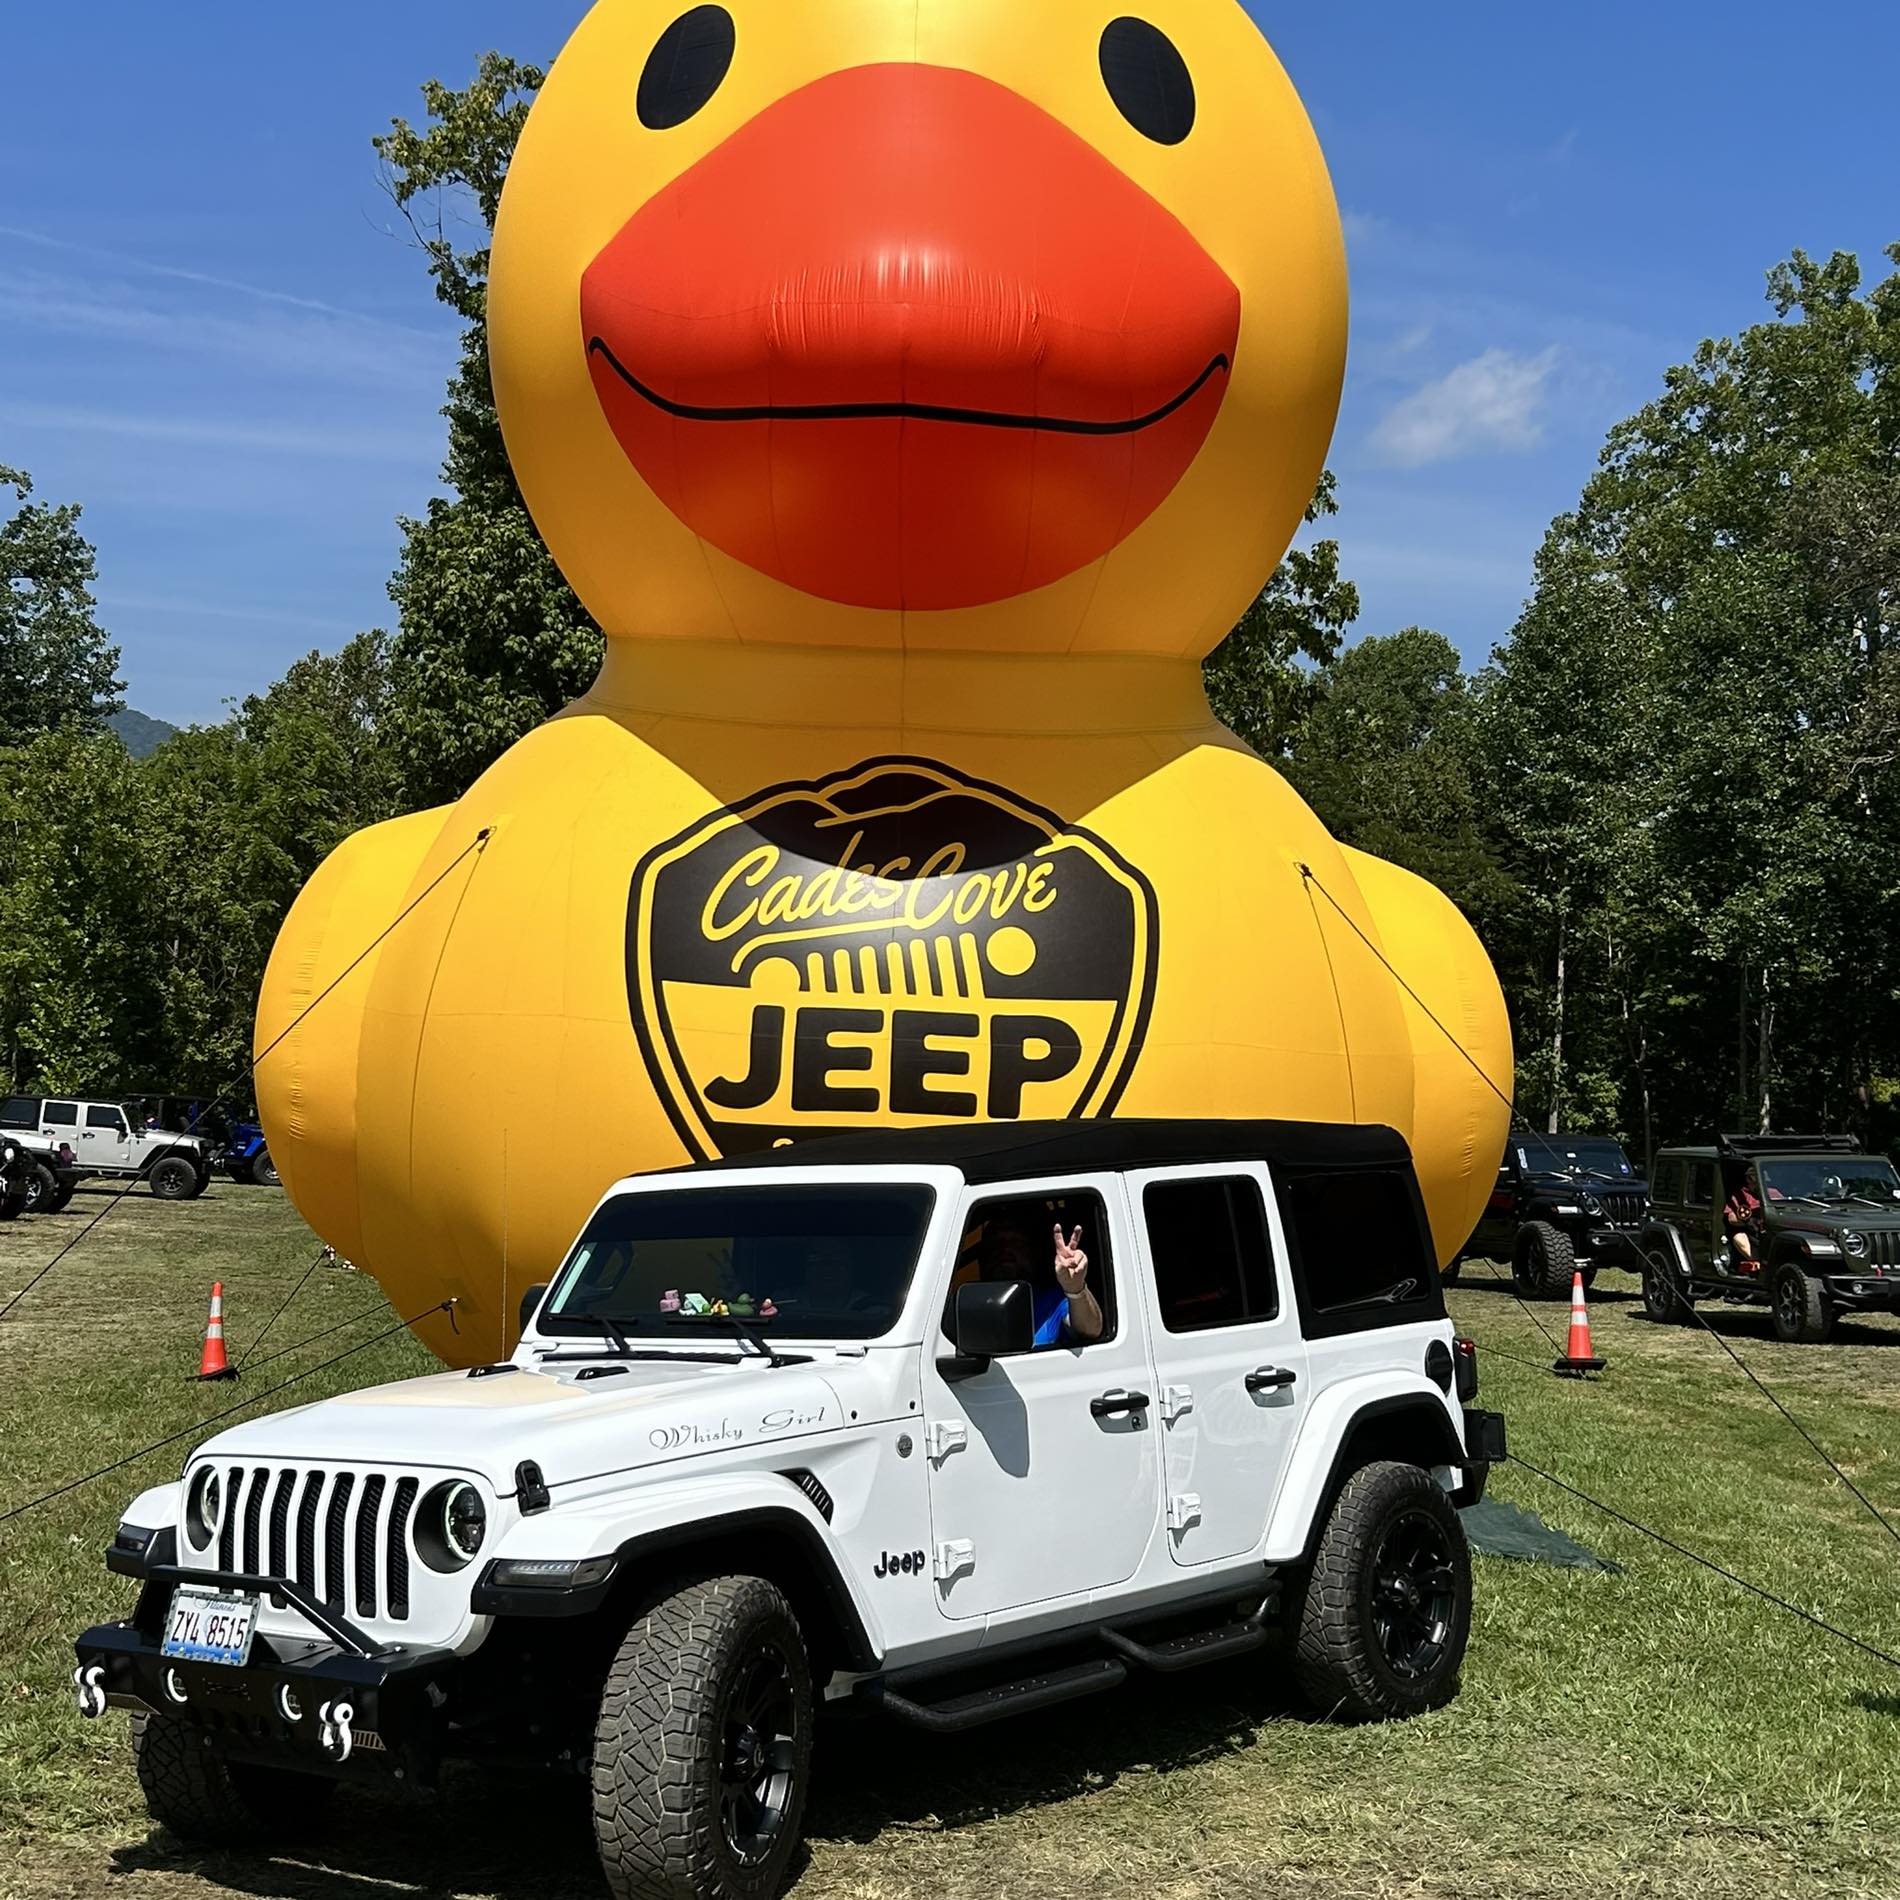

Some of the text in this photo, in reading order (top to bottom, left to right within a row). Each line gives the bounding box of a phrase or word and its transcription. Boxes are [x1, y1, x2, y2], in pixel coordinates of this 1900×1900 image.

[701, 830, 1057, 941] Cades Cove
[703, 1005, 1082, 1119] JEEP
[649, 1407, 825, 1449] Whisky Girl
[873, 1550, 925, 1579] Jeep
[171, 1610, 248, 1649] ZY4 8515
